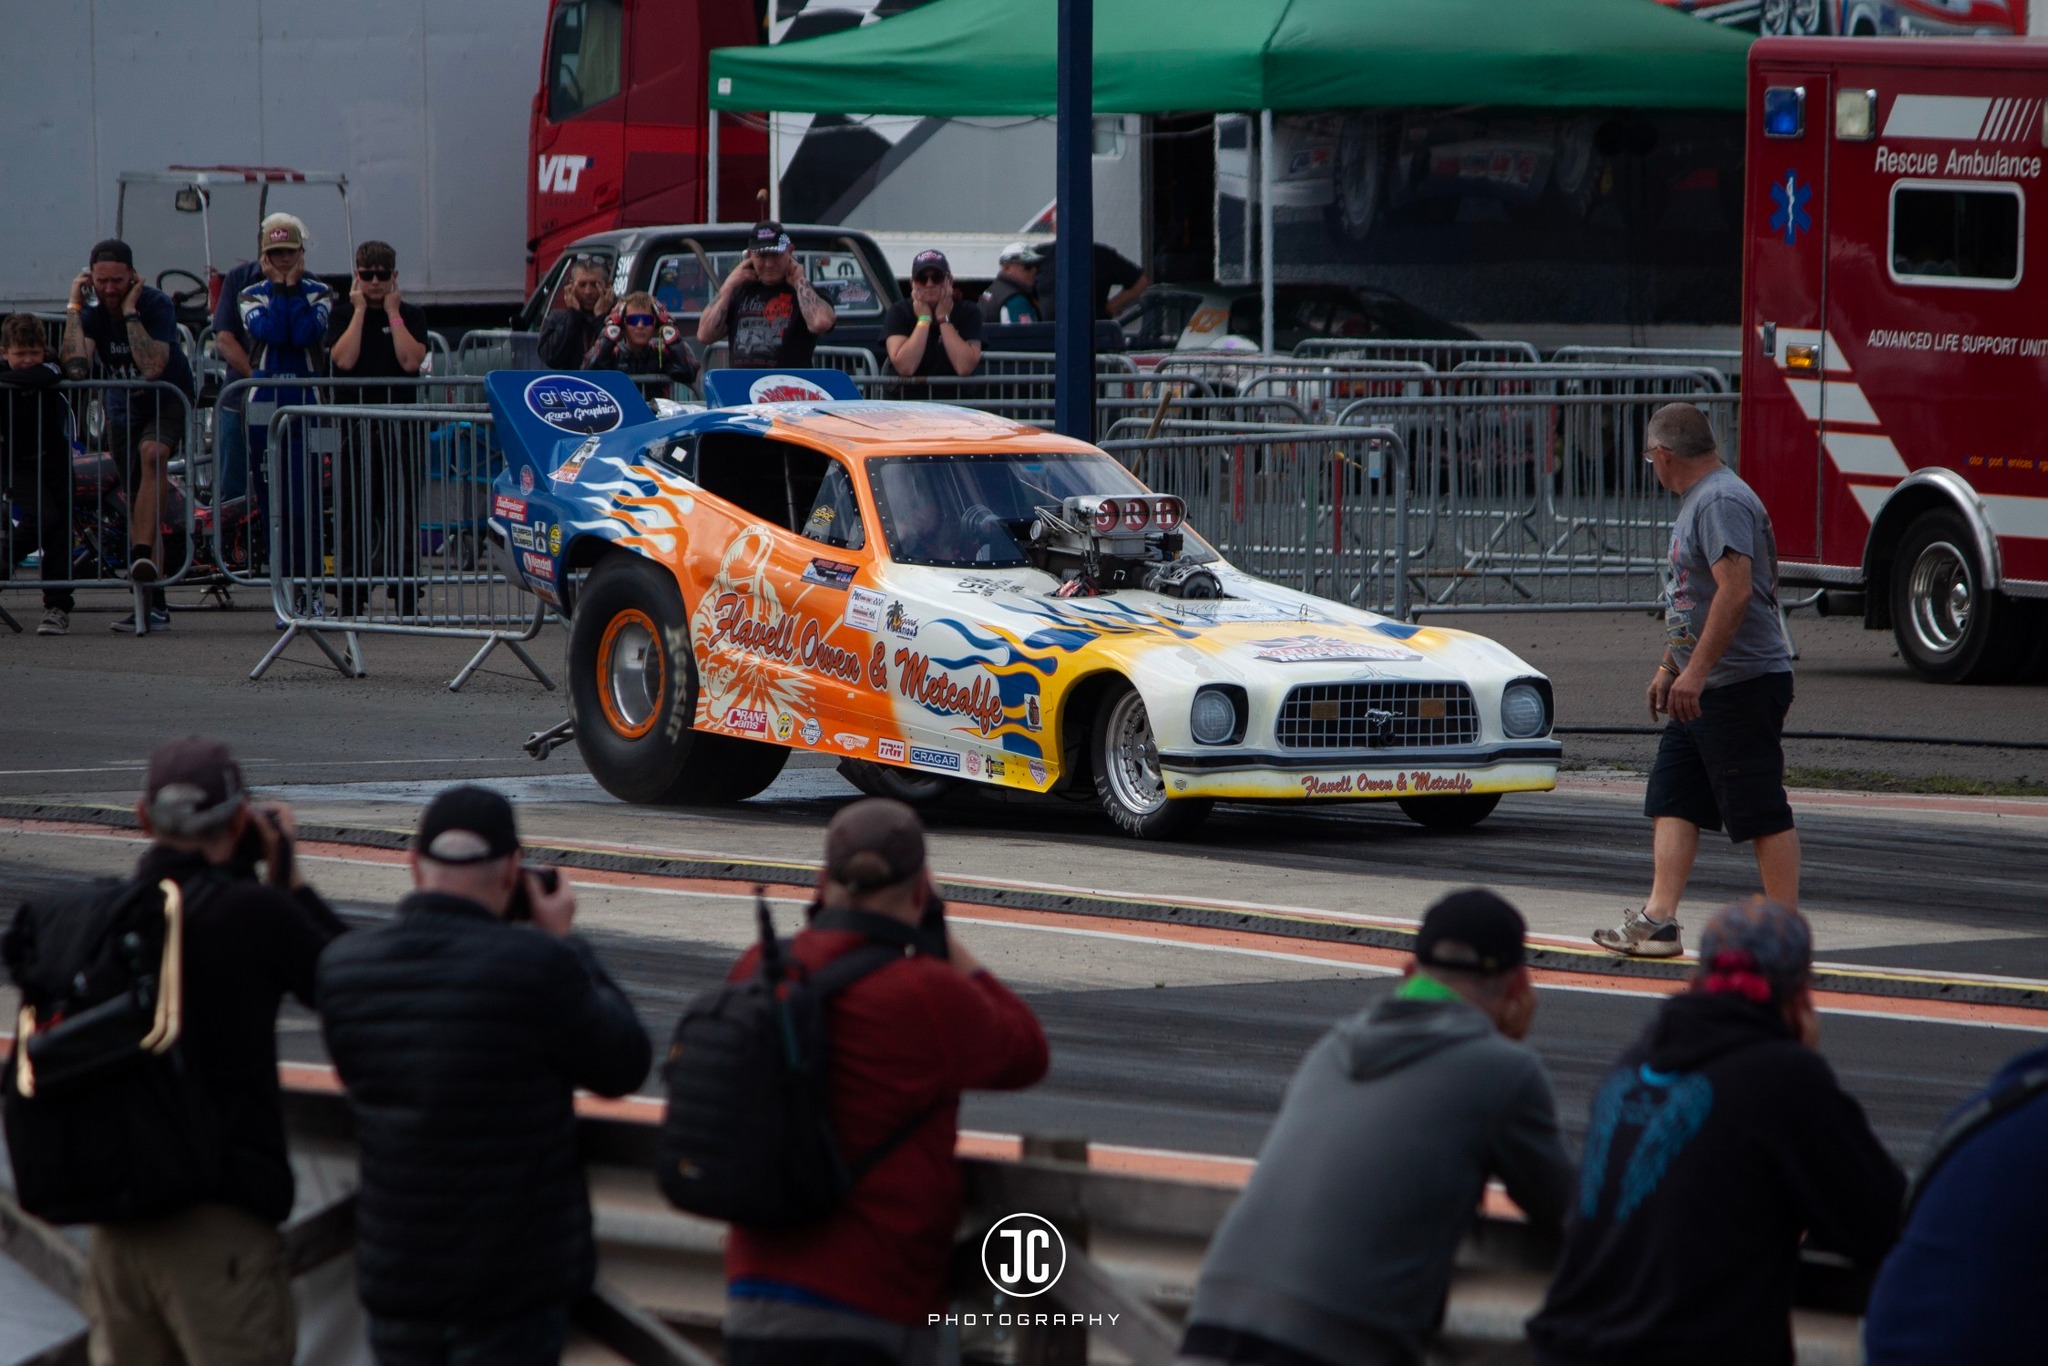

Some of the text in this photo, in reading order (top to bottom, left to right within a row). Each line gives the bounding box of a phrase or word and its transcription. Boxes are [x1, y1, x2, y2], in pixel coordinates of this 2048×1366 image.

[538, 154, 588, 193] VLT
[1875, 145, 2042, 179] Rescue Ambulance
[1867, 329, 1932, 354] ADVANCED
[1934, 332, 1960, 352] LIFE
[1961, 334, 2017, 355] SUPPORT
[544, 404, 617, 423] Race Graphics
[708, 592, 795, 665] Flavell
[799, 618, 861, 683] Owen
[867, 640, 888, 691] &
[894, 645, 1005, 736] Metcalfe
[879, 741, 903, 759] TRW
[912, 751, 957, 768] CRAGAR
[1301, 772, 1473, 800] Flavell Owen & Metcalfe
